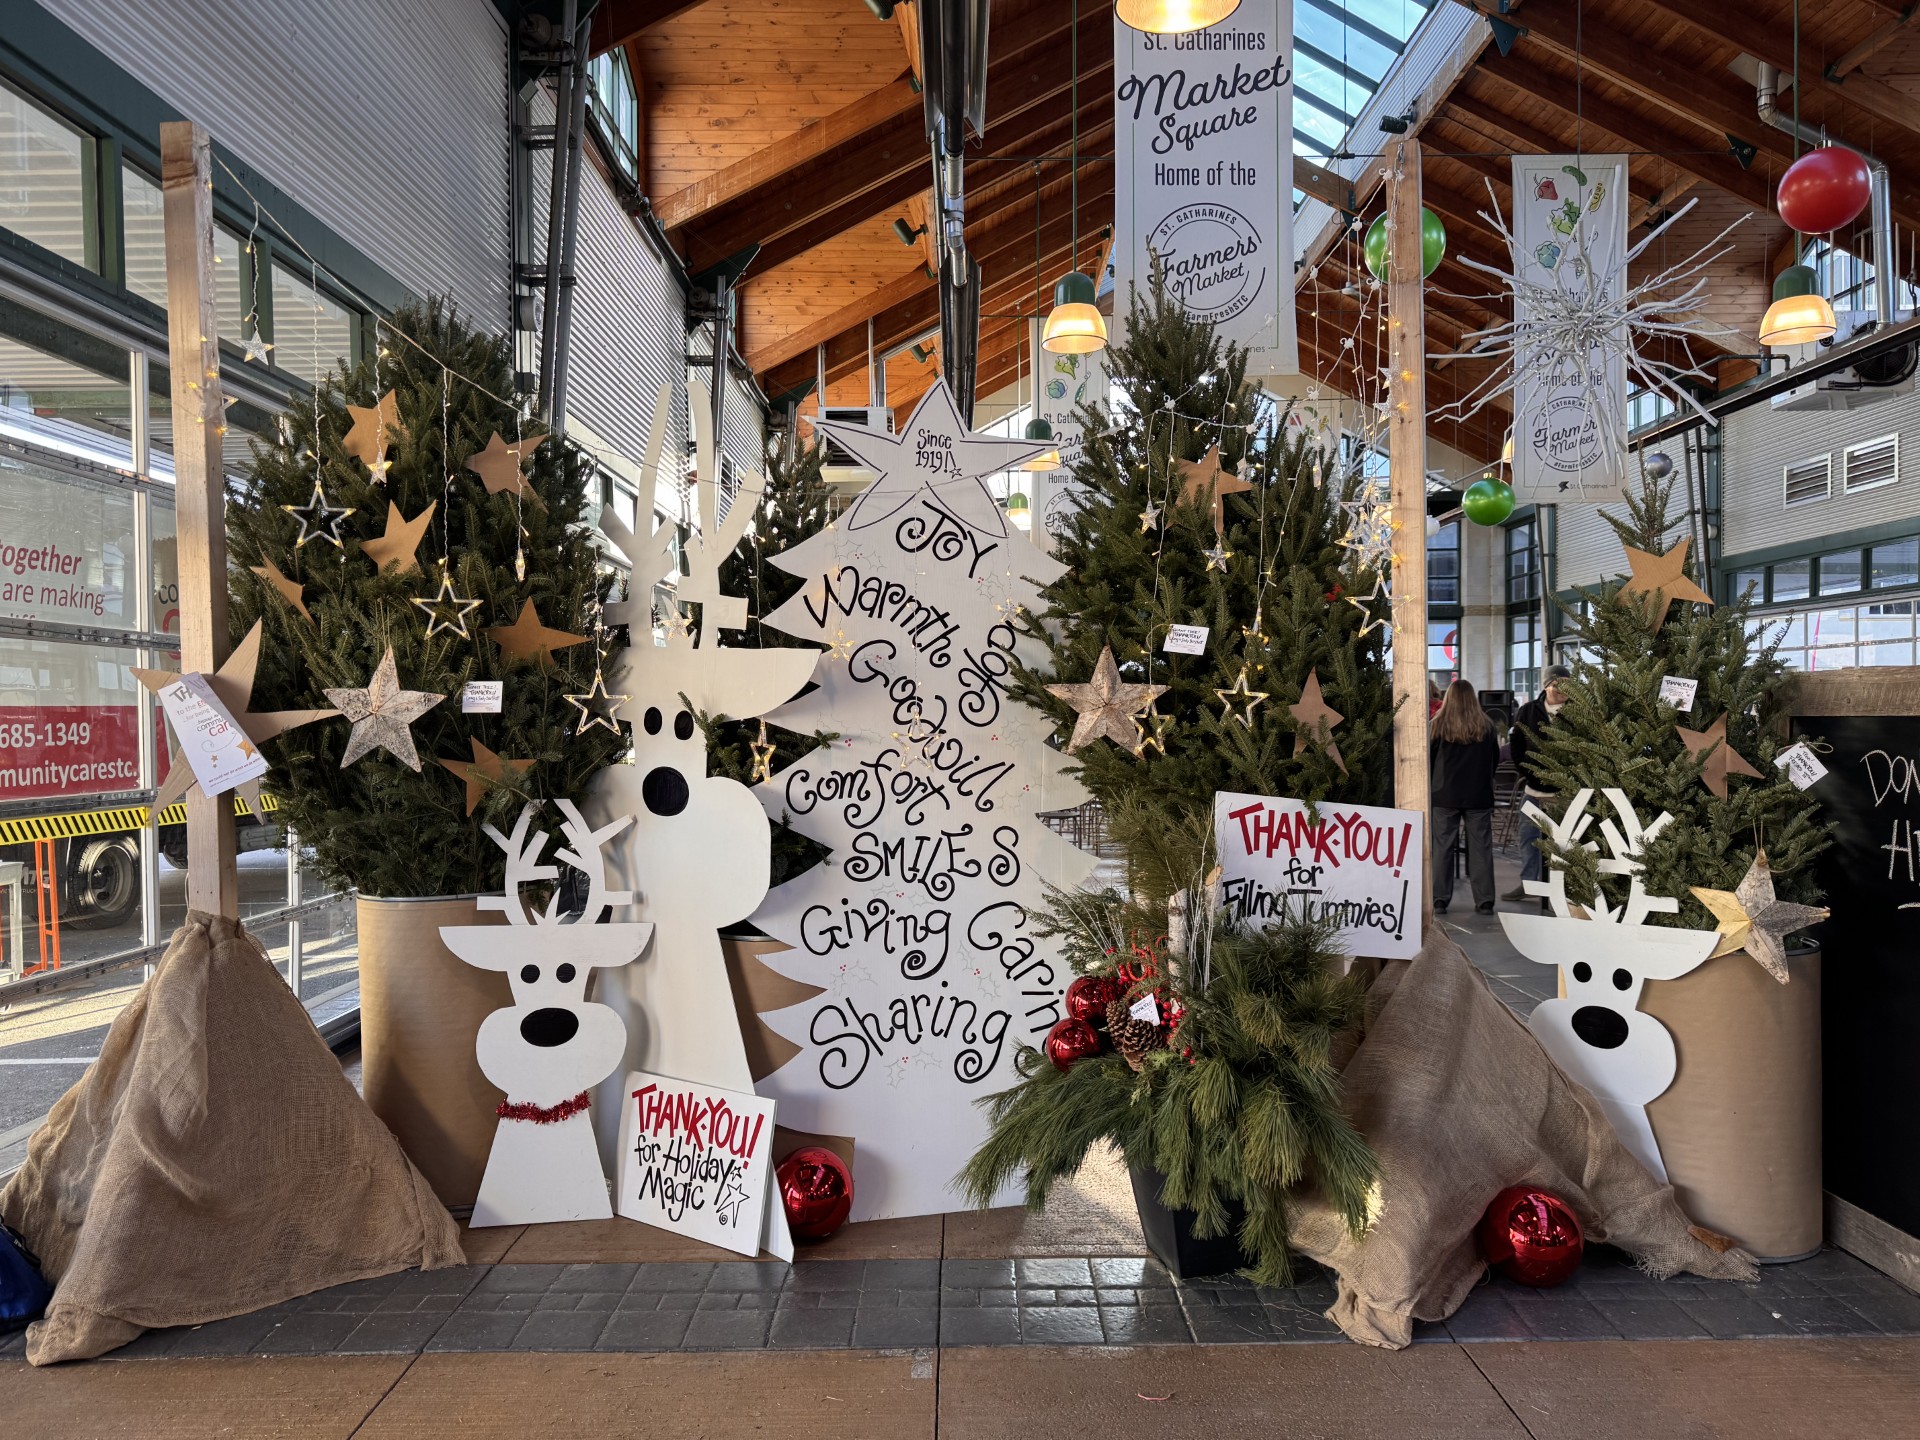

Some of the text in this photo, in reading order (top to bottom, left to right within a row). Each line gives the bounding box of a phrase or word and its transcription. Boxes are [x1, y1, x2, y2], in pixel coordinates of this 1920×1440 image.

[1144, 28, 1266, 50] St. Catharines
[1117, 55, 1291, 120] Market
[1151, 106, 1257, 154] Square
[1155, 161, 1256, 186] Home of the
[1160, 208, 1237, 236] ST. CATHARINES
[1147, 236, 1258, 286] Farmers
[1172, 262, 1244, 300] Market
[917, 428, 952, 449] Since
[1533, 419, 1597, 448] Farmer
[915, 450, 948, 474] 1919!
[1048, 473, 1069, 484] Home
[3, 582, 105, 616] are making
[803, 566, 960, 669] Warmth
[0, 722, 91, 749] 685-1349
[786, 749, 950, 829] Comfort
[844, 823, 1021, 900] SMILES
[1283, 857, 1324, 887] for
[1287, 883, 1409, 941] Tummies!
[800, 898, 952, 980] Giving
[810, 980, 1012, 1090] Sharing
[634, 1135, 736, 1206] for Holiday
[638, 1165, 705, 1222] Magic
